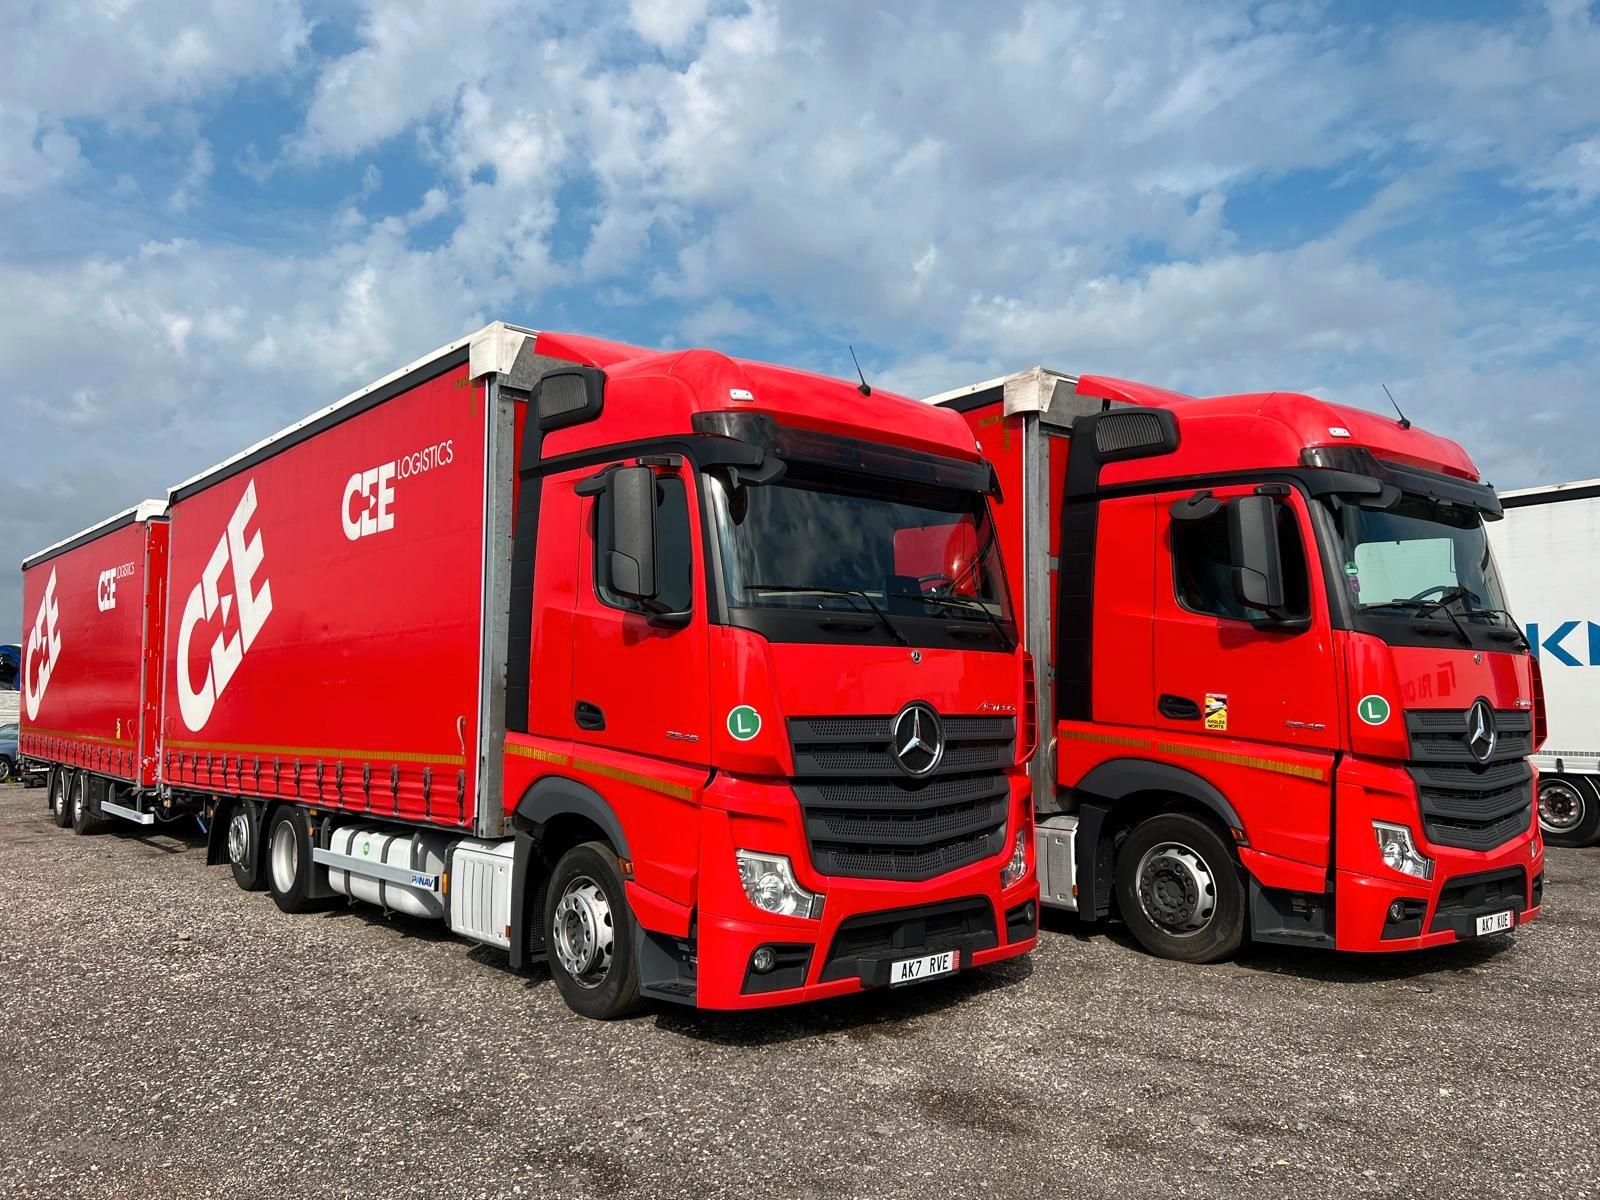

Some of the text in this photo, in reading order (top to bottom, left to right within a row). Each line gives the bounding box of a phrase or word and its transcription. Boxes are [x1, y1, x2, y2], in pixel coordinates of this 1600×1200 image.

[341, 440, 454, 540] CEE LOGISTICS
[97, 567, 116, 612] CEE
[176, 478, 273, 732] CEE
[25, 565, 61, 721] CEE
[737, 713, 752, 732] L
[1367, 701, 1382, 718] L
[901, 954, 949, 979] AK7 RVE
